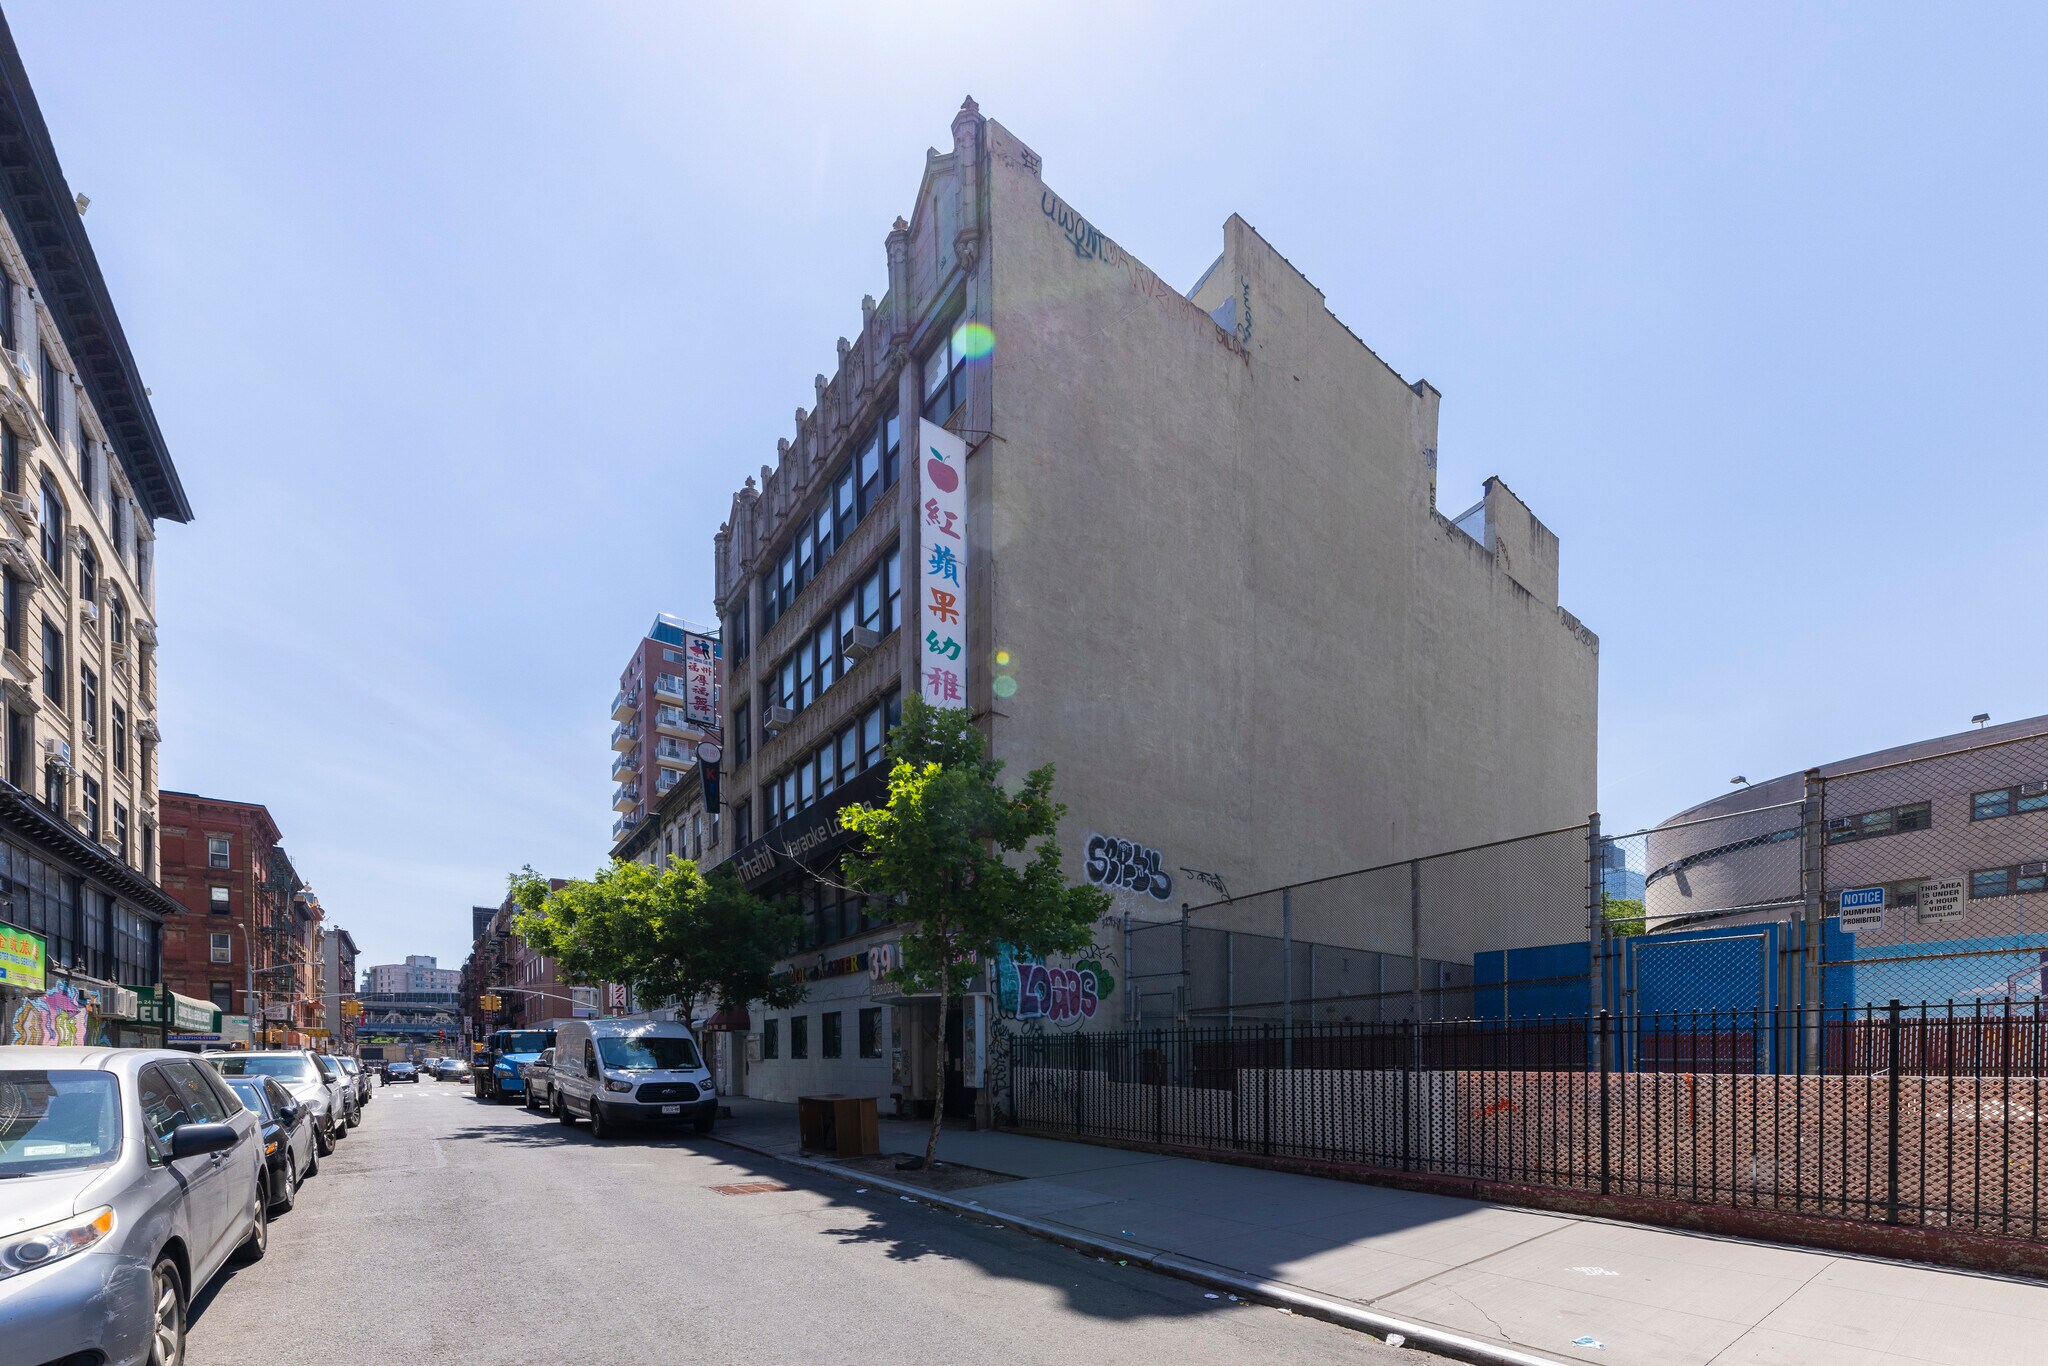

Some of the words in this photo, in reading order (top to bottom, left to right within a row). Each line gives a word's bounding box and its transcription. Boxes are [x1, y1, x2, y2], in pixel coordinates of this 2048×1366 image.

[783, 824, 828, 861] Karaoke
[1844, 891, 1881, 905] NOTICE
[1932, 889, 1960, 898] UNDER
[1843, 906, 1881, 916] DUMPING
[1929, 904, 1953, 912] VIDEO
[1920, 910, 1962, 919] SURVEILLANCE
[1843, 916, 1881, 925] PROHIBITED
[869, 943, 891, 982] 39
[128, 1006, 171, 1022] ELI
